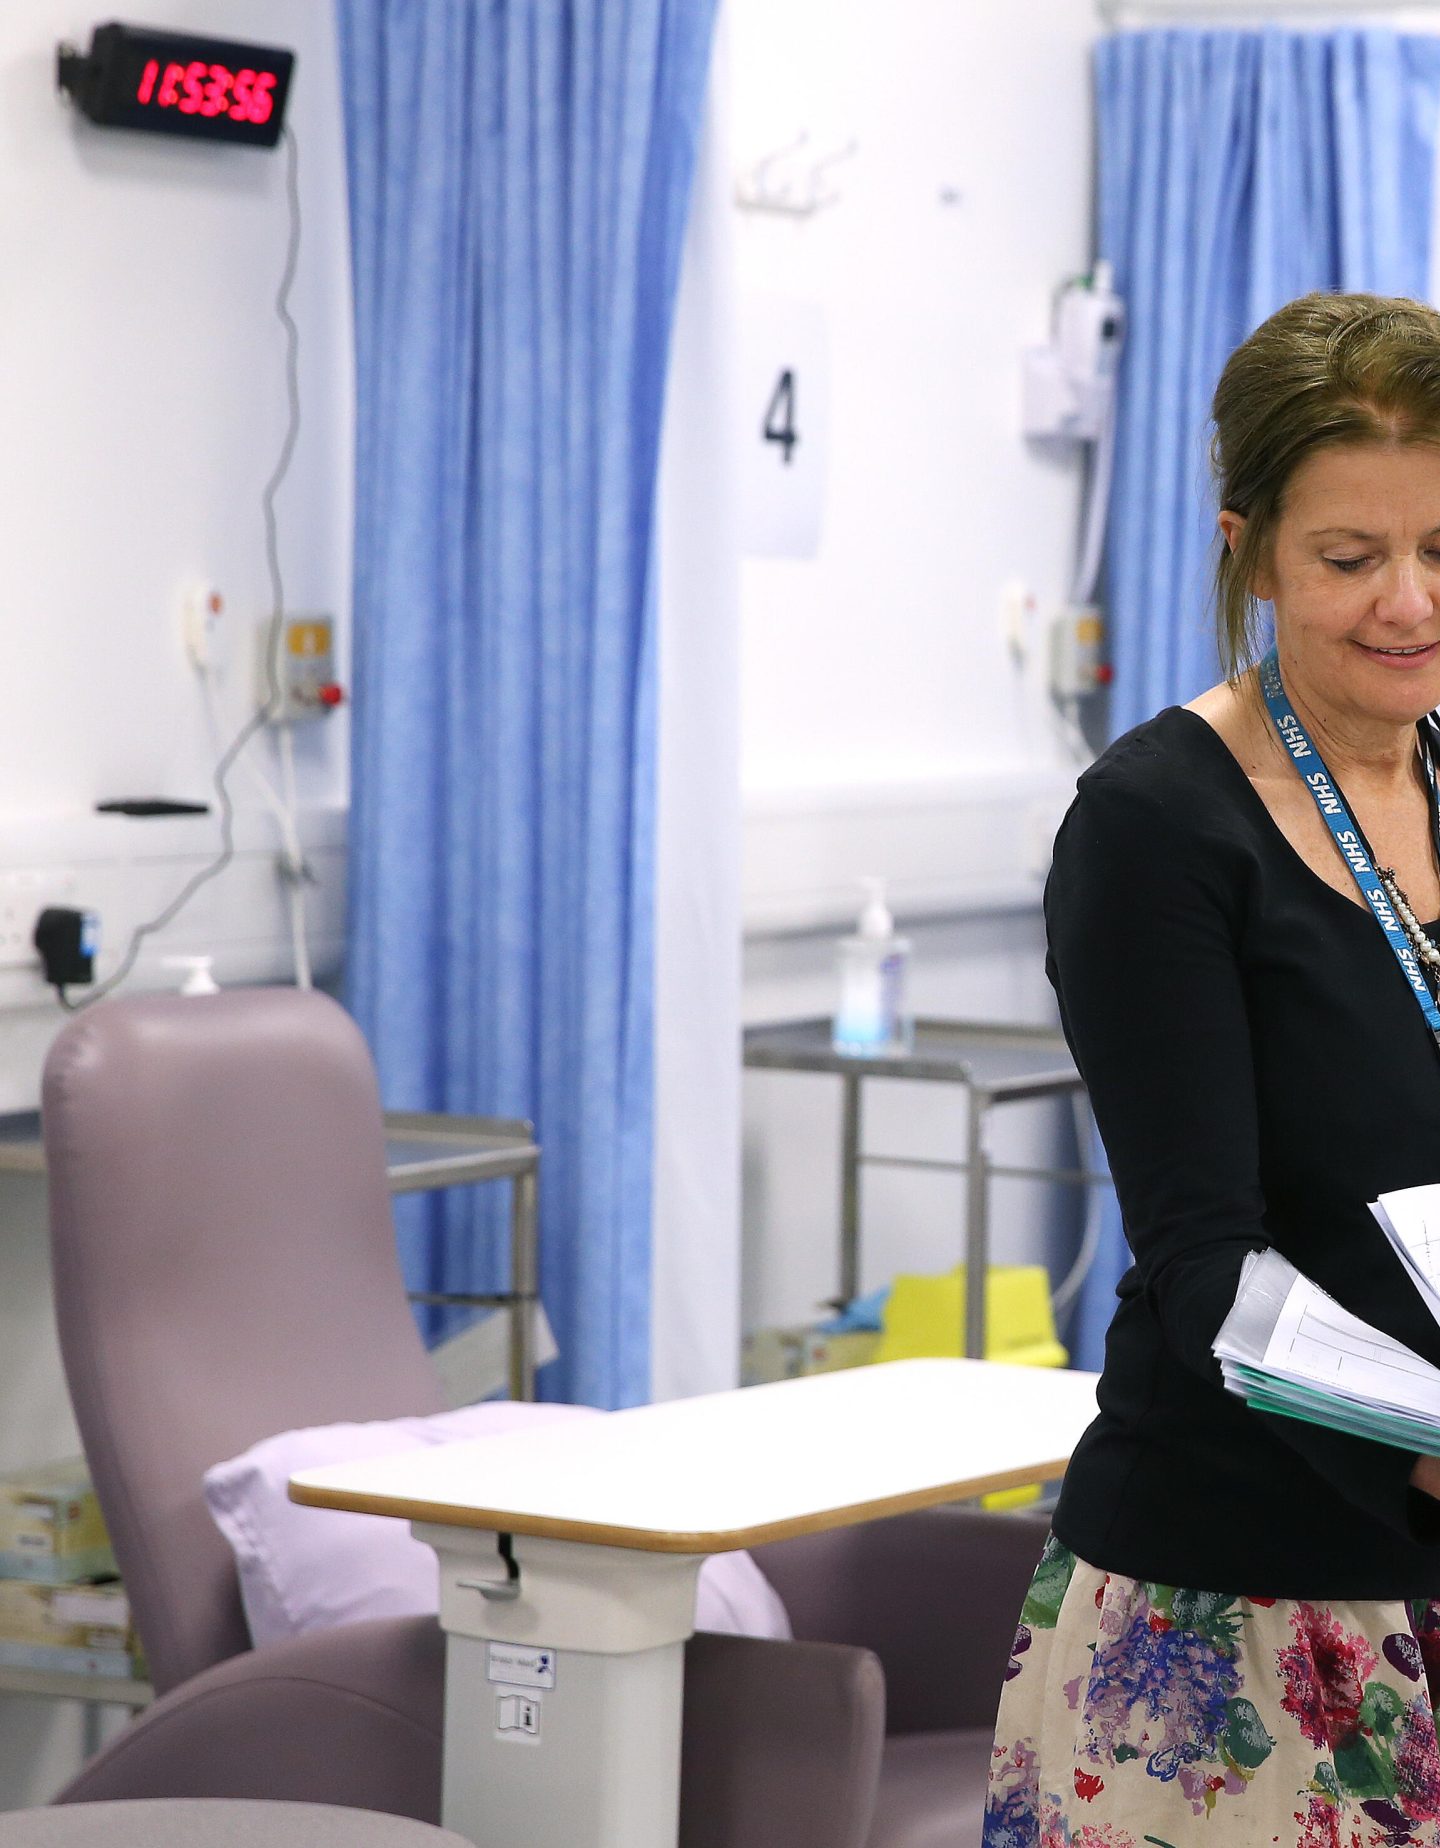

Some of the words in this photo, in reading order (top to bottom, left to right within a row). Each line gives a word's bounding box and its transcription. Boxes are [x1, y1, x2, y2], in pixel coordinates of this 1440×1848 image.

[763, 368, 798, 464] 4
[1277, 714, 1312, 758] NHS
[1306, 772, 1342, 815] NHS
[1337, 830, 1371, 873] NHS
[1366, 888, 1400, 932] NHS
[1396, 948, 1427, 992] NHS
